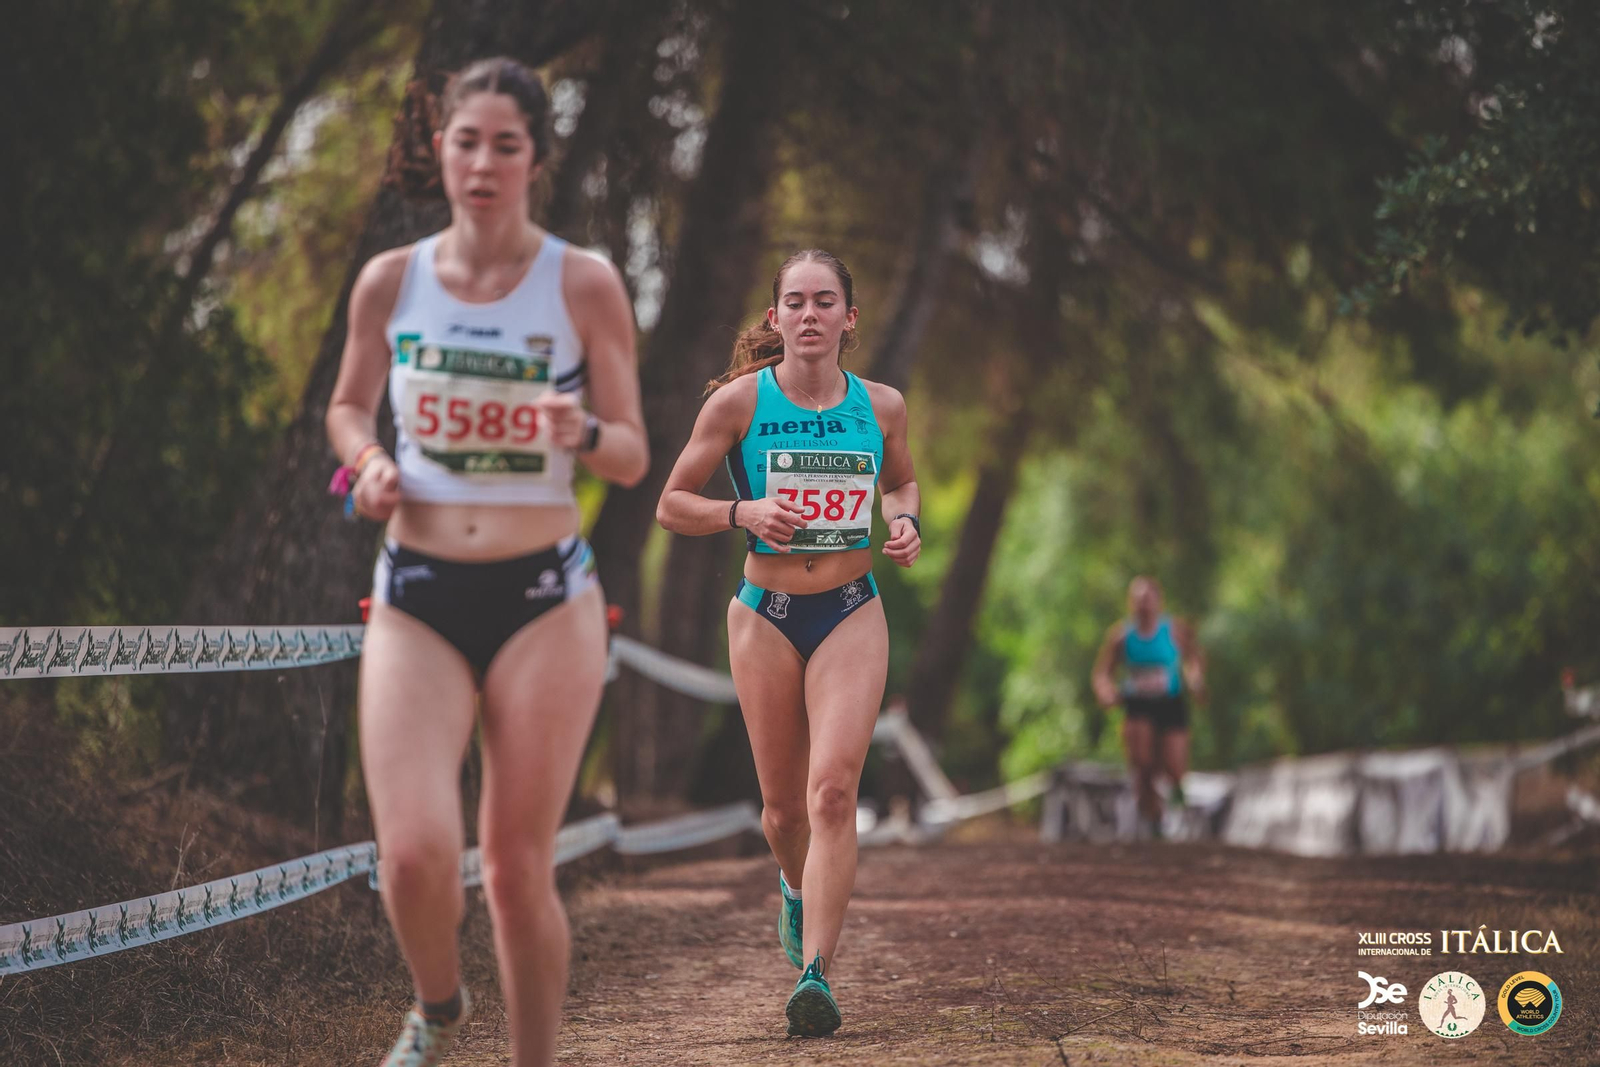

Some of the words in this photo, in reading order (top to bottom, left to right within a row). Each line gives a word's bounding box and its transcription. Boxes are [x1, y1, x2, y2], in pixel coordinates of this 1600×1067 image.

[416, 394, 539, 444] 5589
[758, 415, 847, 438] nerja
[770, 439, 838, 449] ATLETISMO
[800, 453, 851, 467] ITÁLICA
[778, 488, 867, 522] 7587
